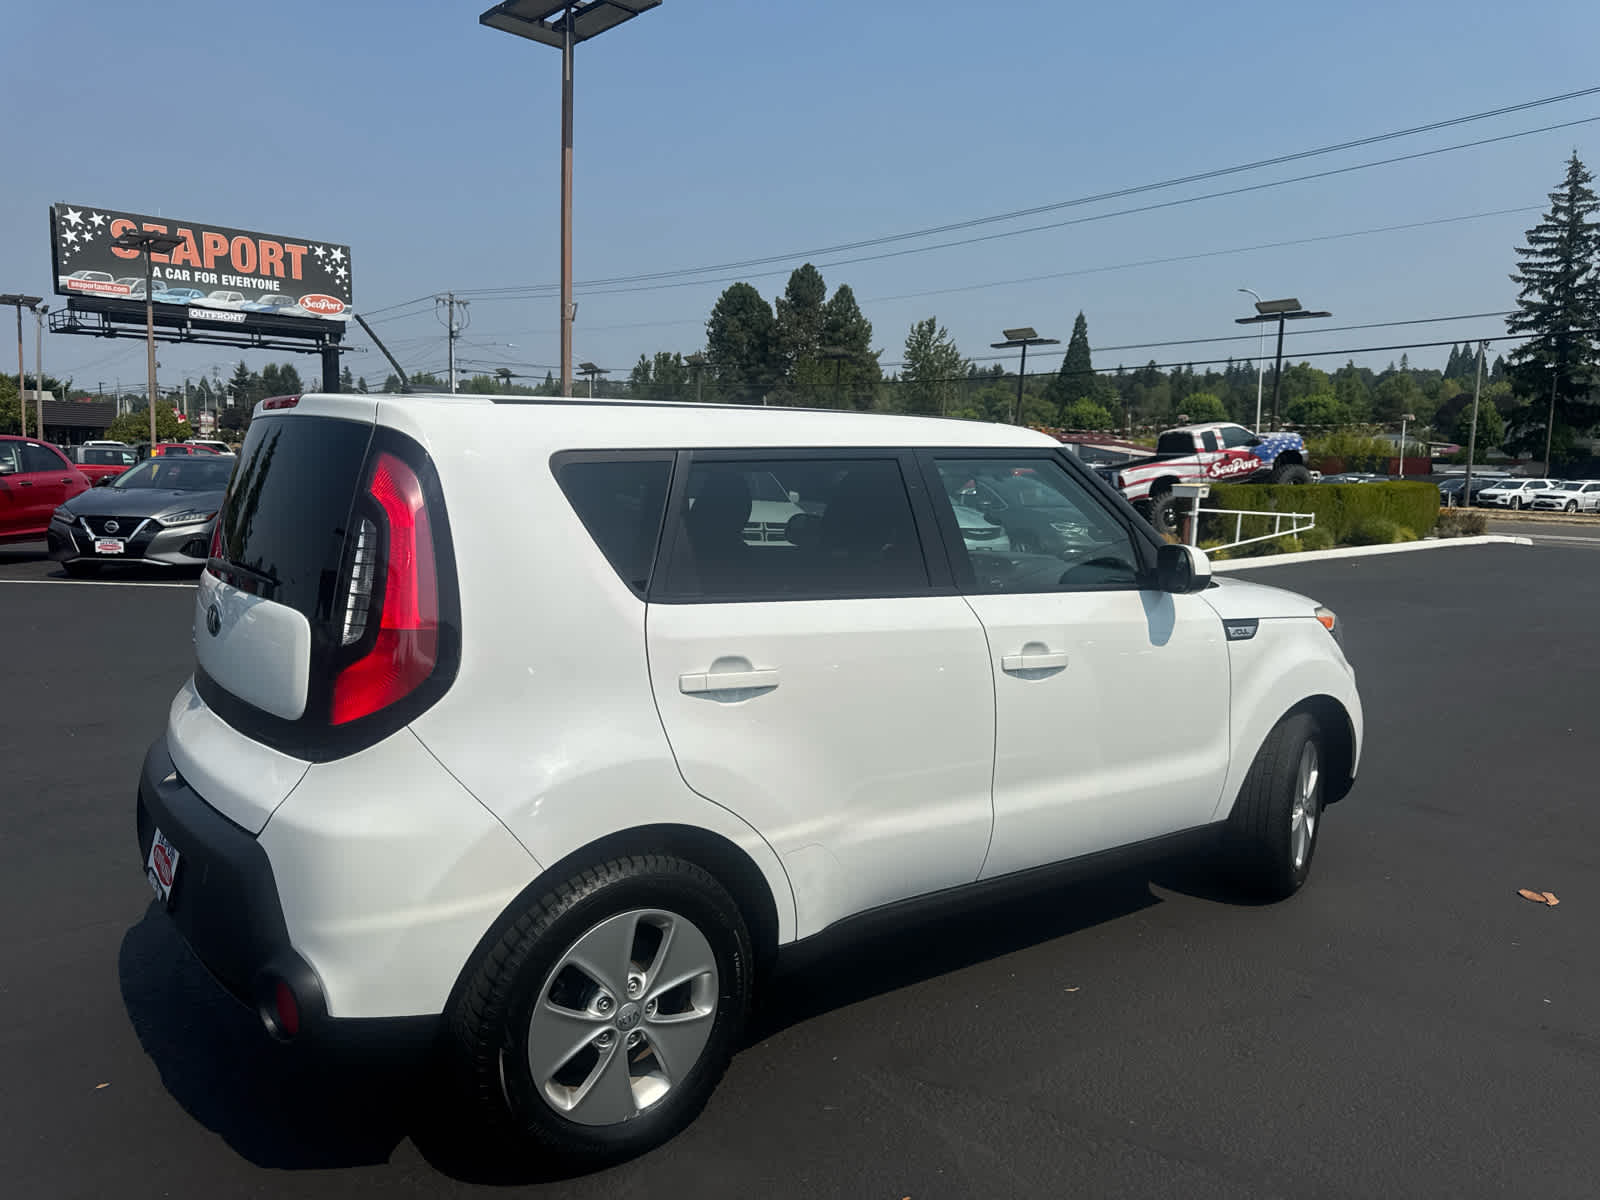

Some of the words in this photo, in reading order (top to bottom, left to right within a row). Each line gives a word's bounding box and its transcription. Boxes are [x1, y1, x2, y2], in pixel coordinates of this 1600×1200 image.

[152, 266, 162, 278] A
[165, 268, 190, 281] CAR
[194, 271, 218, 284] FOR
[222, 274, 281, 291] EVERYONE
[302, 296, 341, 311] SeaPort
[190, 310, 244, 322] OUTFRONT
[1209, 458, 1259, 477] SeaPort
